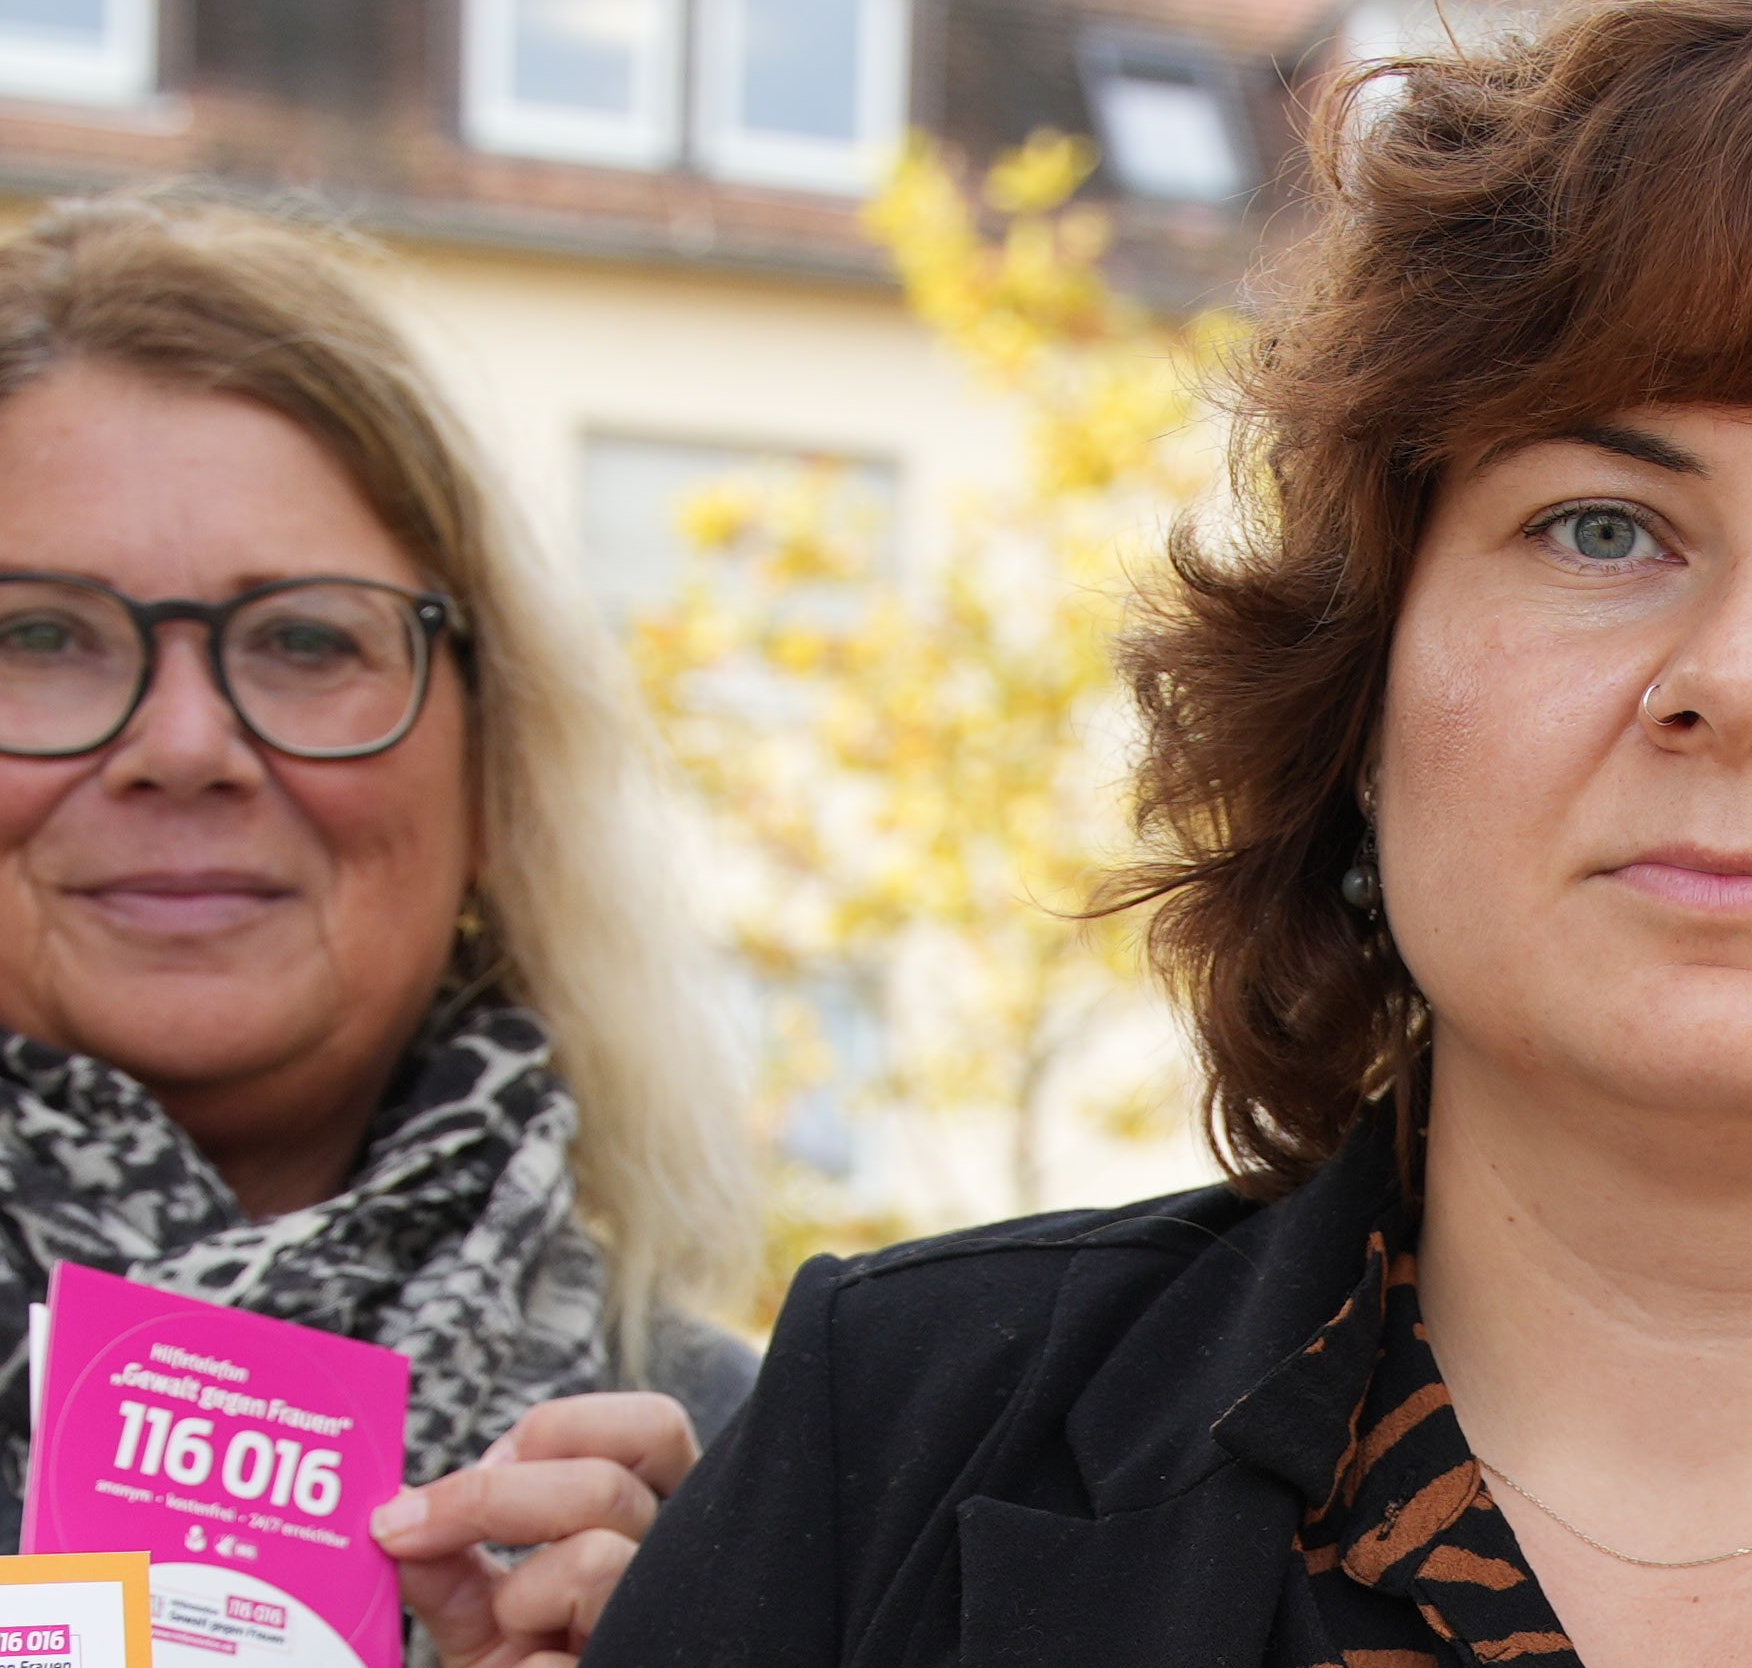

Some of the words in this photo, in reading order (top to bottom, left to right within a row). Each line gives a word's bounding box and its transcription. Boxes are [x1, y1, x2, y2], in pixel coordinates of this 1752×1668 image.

[198, 1386, 268, 1419] gegen
[112, 1399, 215, 1485] 116
[222, 1430, 344, 1516] 016
[26, 1629, 66, 1652] 016
